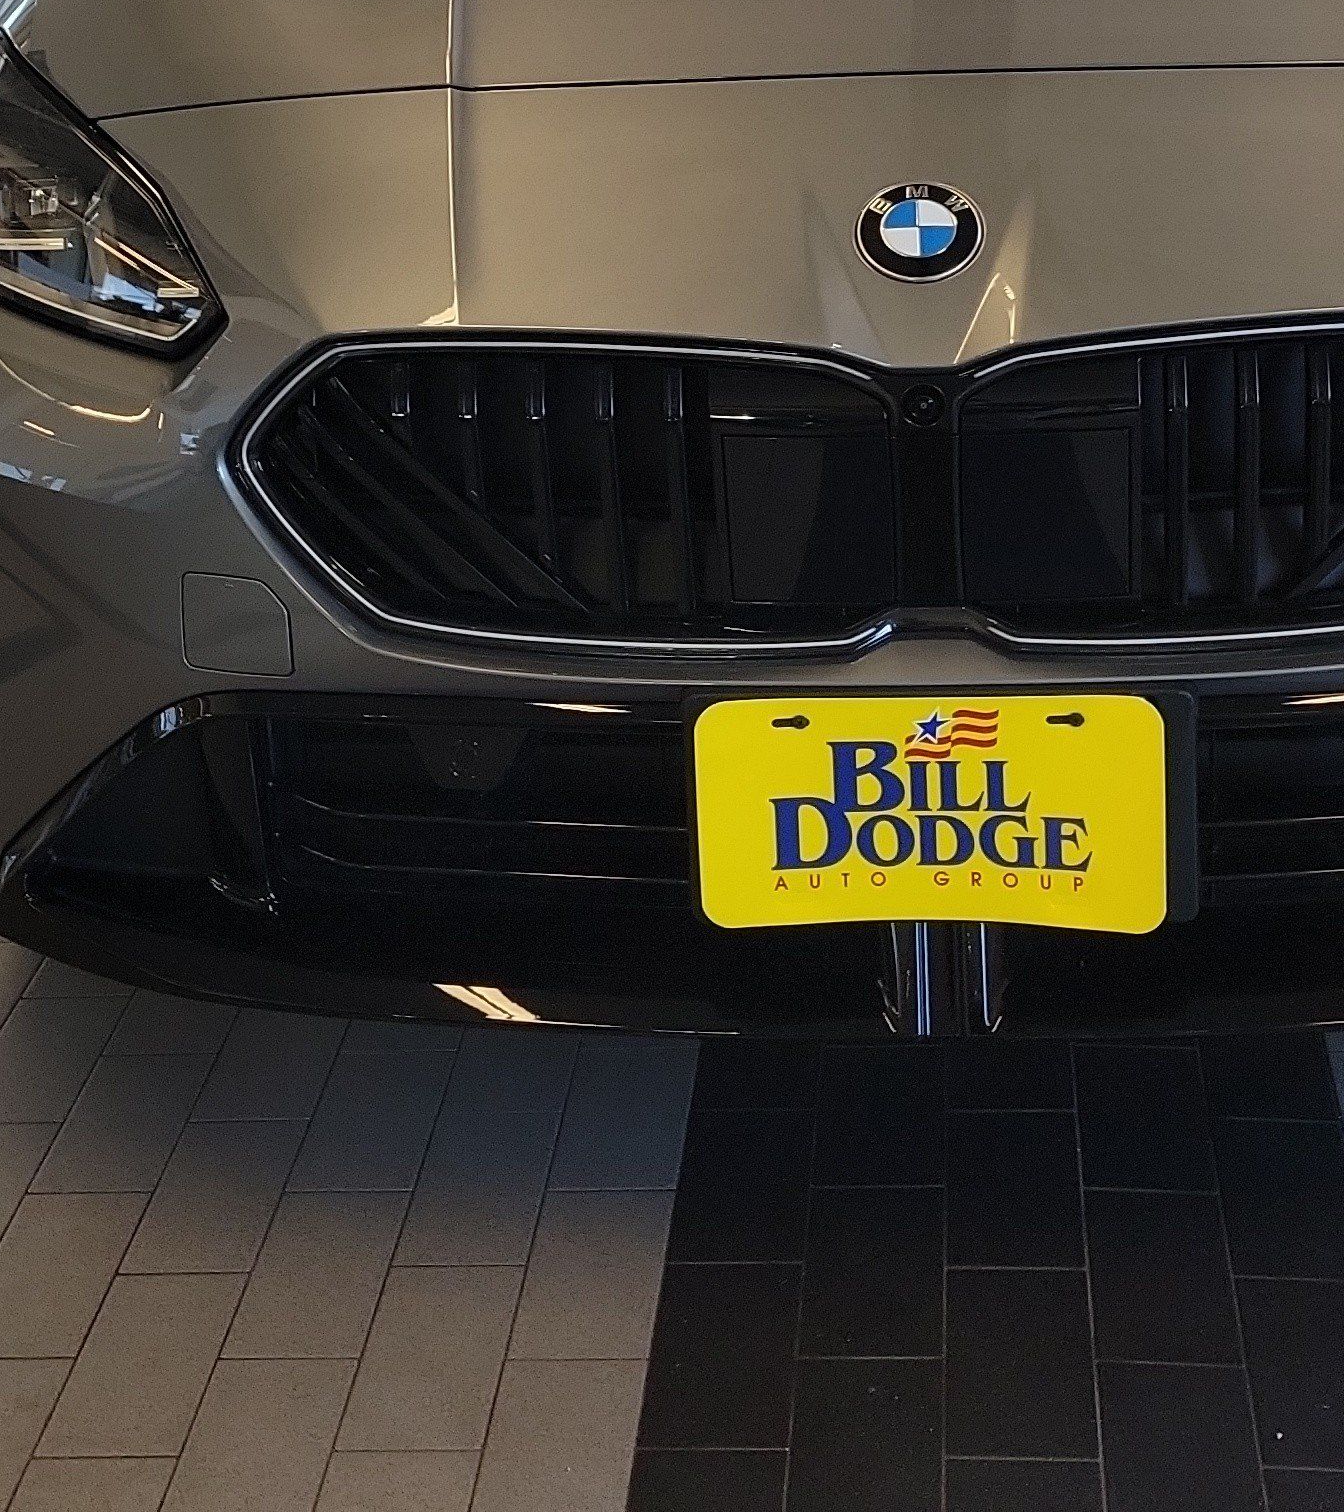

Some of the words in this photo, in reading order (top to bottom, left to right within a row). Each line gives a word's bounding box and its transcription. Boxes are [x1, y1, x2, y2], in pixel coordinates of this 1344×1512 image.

[869, 185, 968, 214] BMW
[826, 740, 1031, 813] BILL
[769, 797, 1093, 872] DODGE
[774, 872, 887, 892] AUTO
[934, 870, 1086, 893] GROUP
